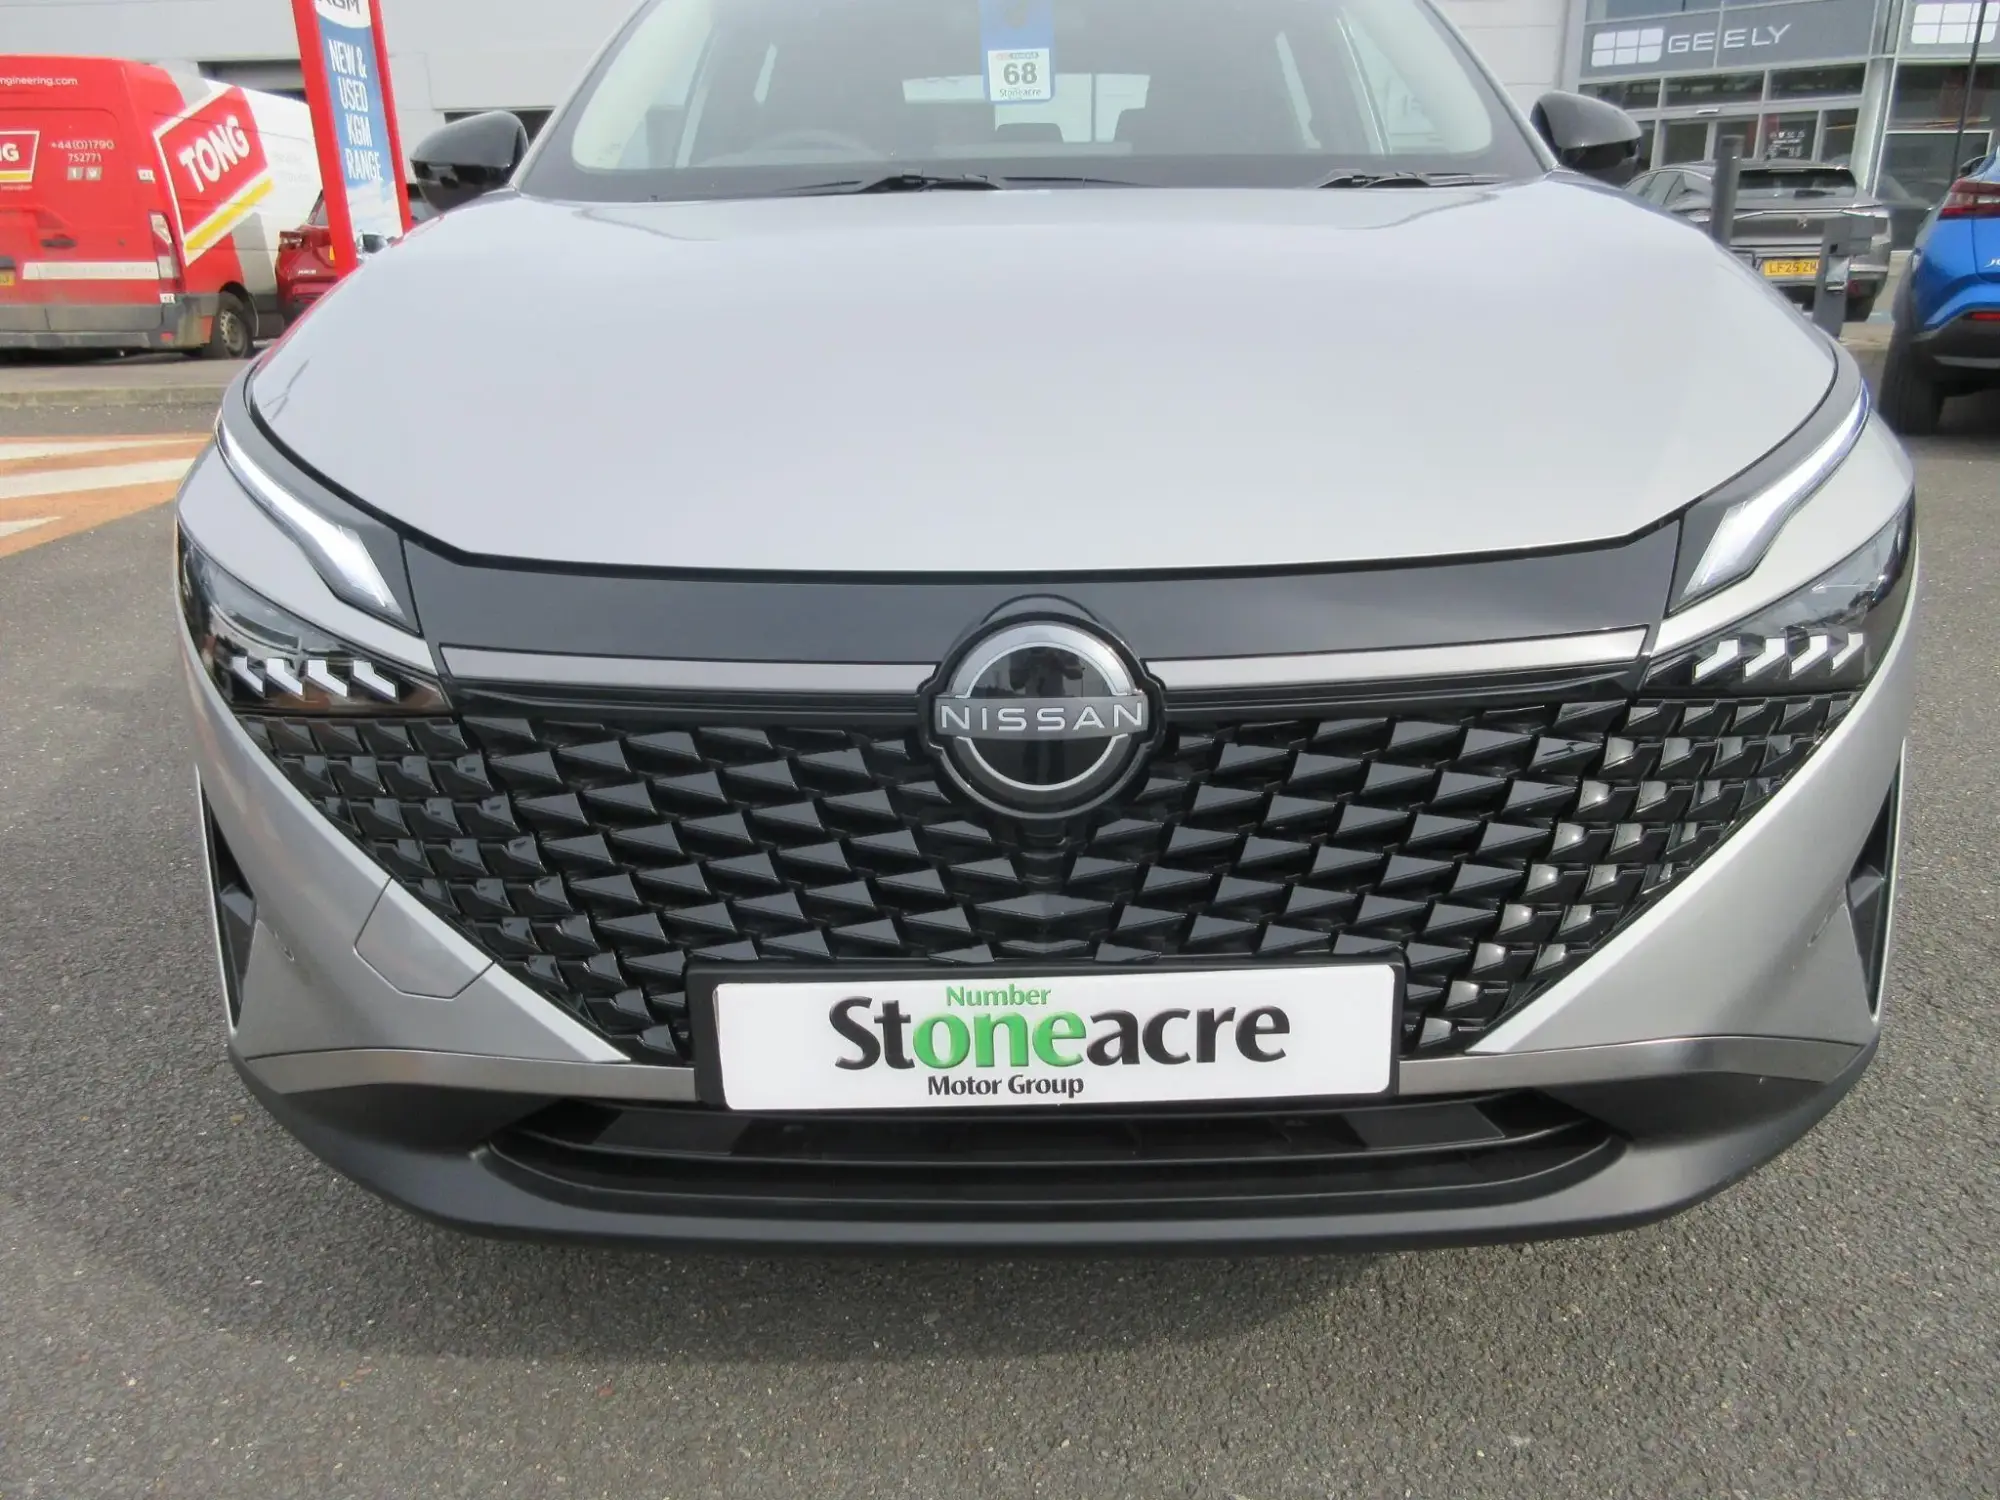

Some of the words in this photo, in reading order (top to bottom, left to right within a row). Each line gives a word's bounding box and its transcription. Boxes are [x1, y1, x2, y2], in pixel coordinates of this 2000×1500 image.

[1668, 23, 1791, 53] GEELY
[327, 39, 357, 76] NEW
[356, 46, 368, 79] &
[1003, 62, 1038, 85] 68
[338, 76, 369, 112] USED
[345, 112, 373, 147] KGM
[179, 115, 250, 193] TONG
[344, 147, 384, 181] RANGE
[941, 703, 1142, 731] NISSAN
[946, 984, 1051, 1006] Number
[829, 996, 1290, 1070] Stoneacre
[928, 1075, 1002, 1095] Motor
[1008, 1074, 1084, 1098] Group
